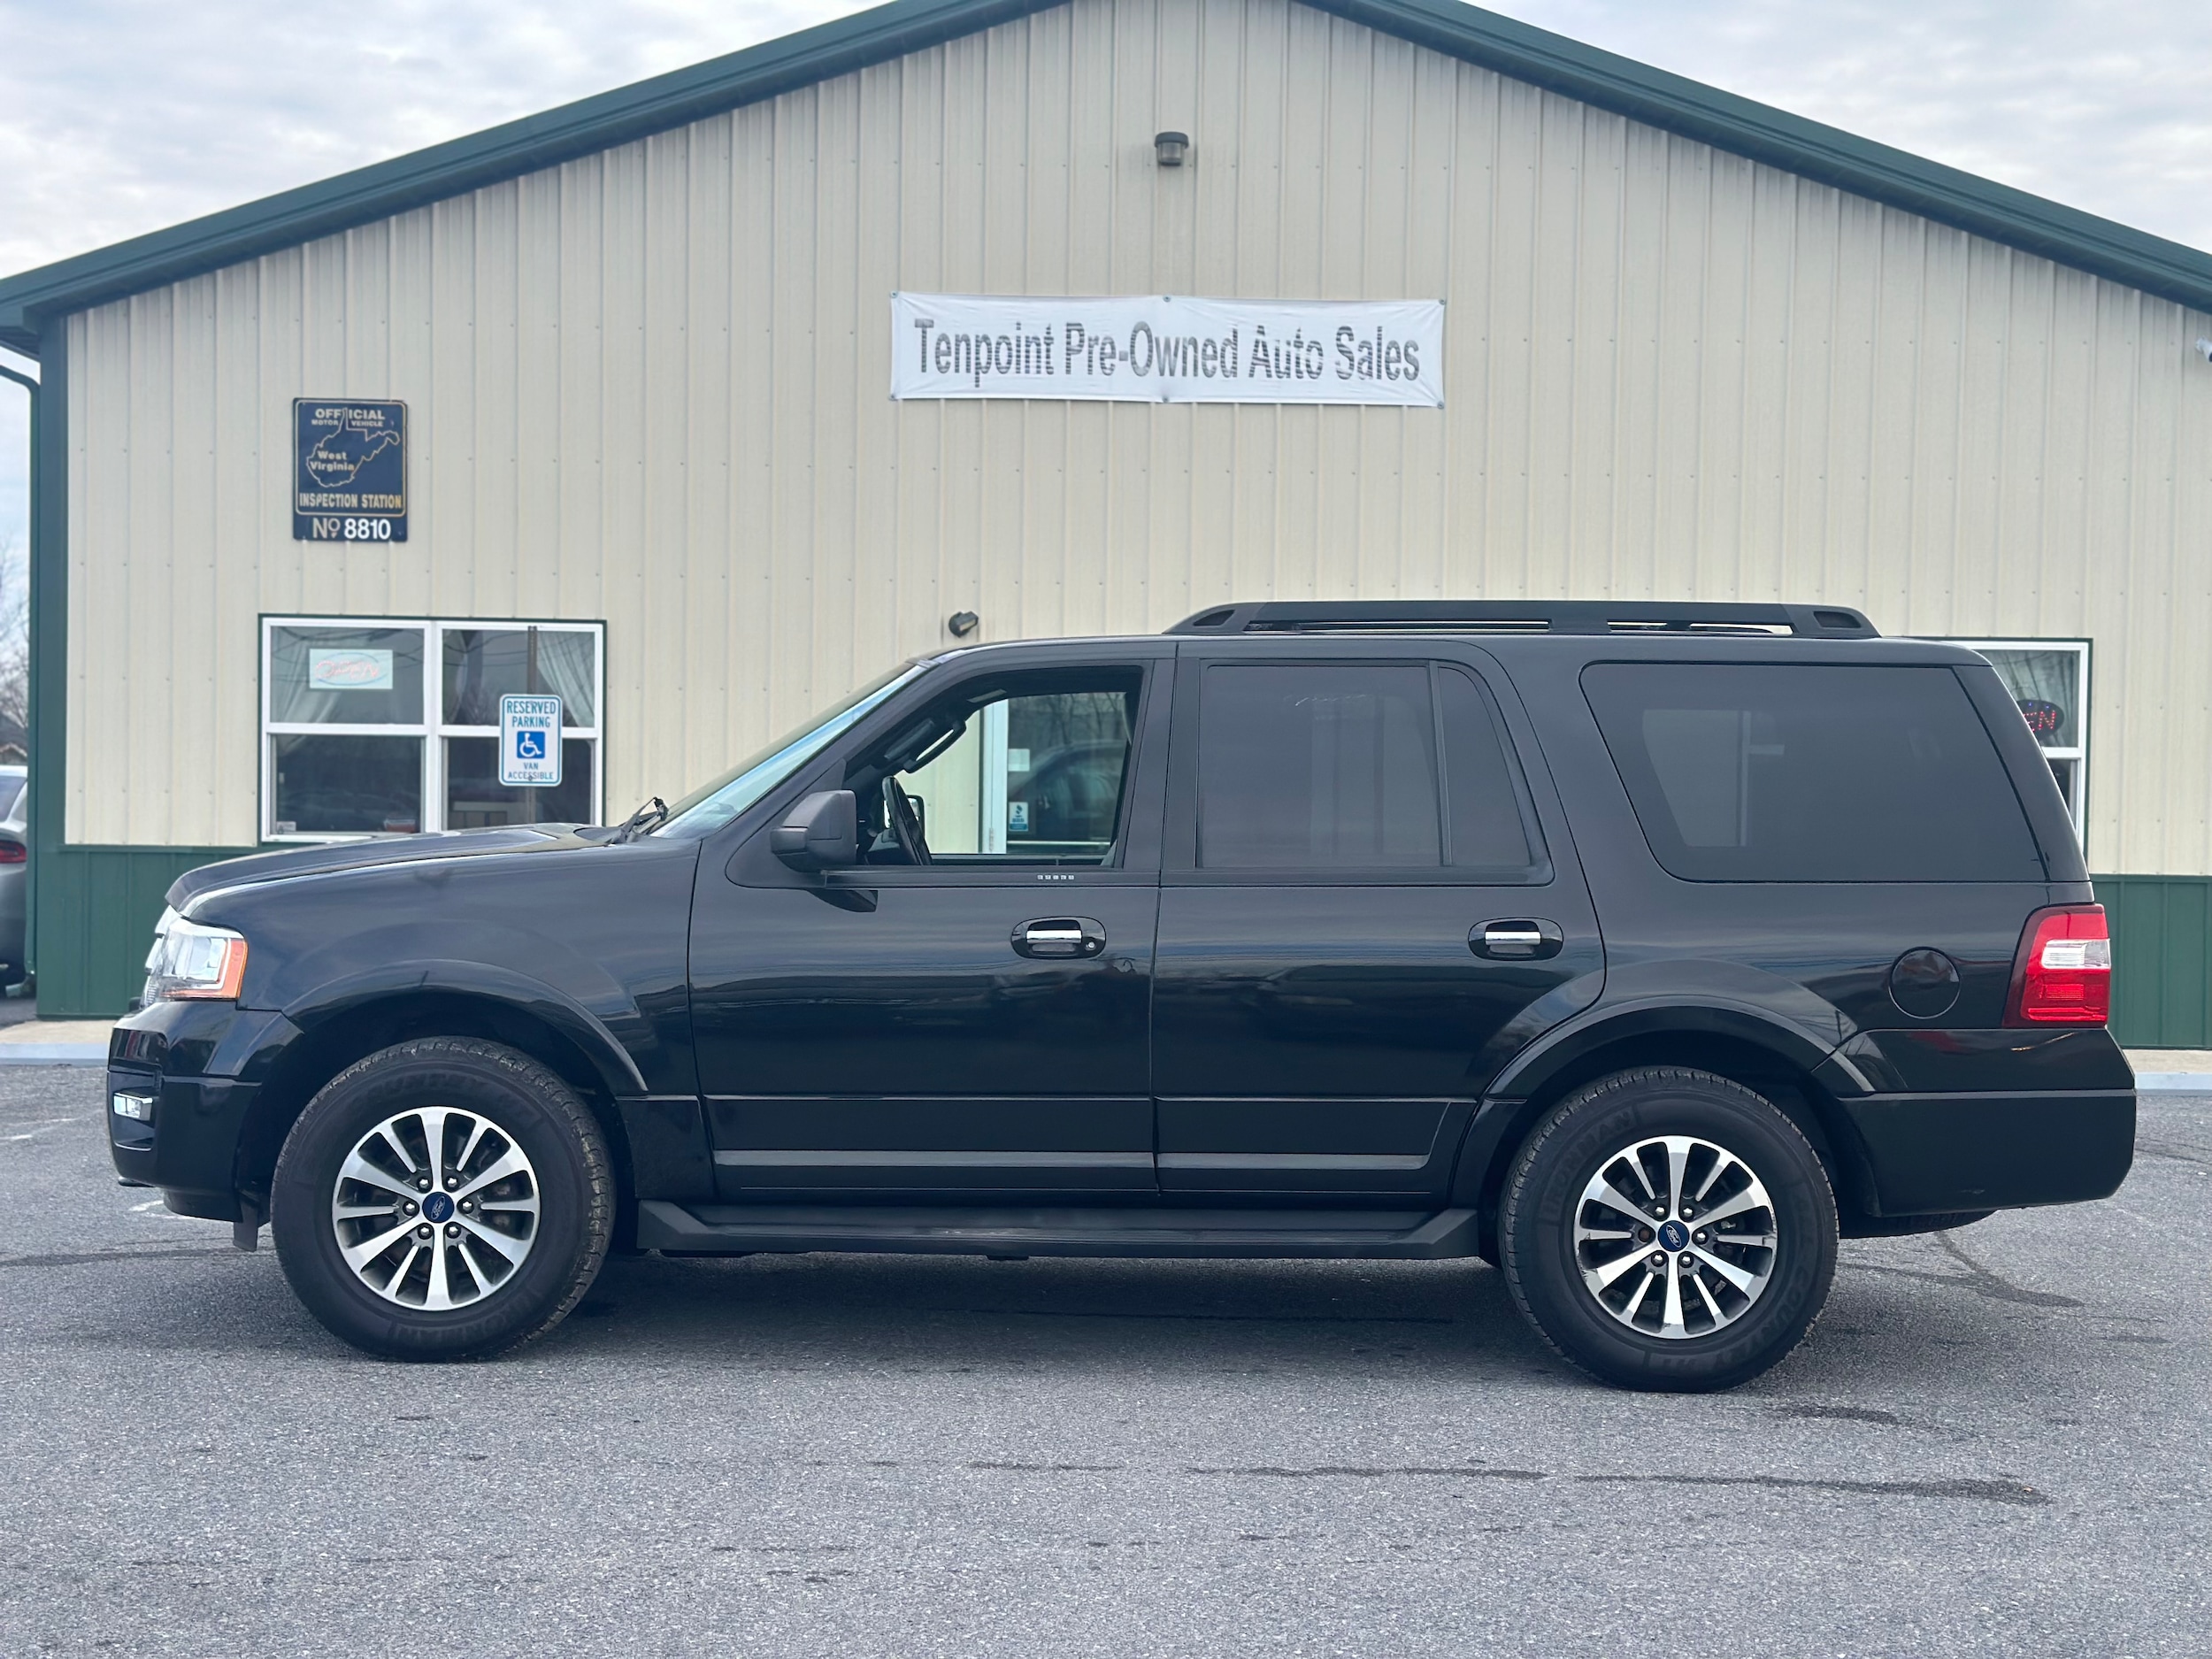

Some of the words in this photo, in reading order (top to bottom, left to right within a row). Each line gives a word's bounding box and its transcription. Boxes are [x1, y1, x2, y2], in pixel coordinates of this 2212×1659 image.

[914, 319, 1055, 388] Tenpoint
[1064, 320, 1239, 379] Pre-Owned
[1248, 325, 1325, 380] Auto
[1335, 325, 1419, 381] Sales
[317, 450, 348, 460] West
[310, 461, 356, 472] Virginia
[299, 493, 358, 508] INSPECTION
[361, 494, 403, 509] STATION
[343, 518, 392, 540] 8810
[506, 700, 557, 714] RESERVED
[511, 716, 551, 728] PARKING
[523, 762, 539, 771] VAN
[507, 772, 555, 780] ACCESSIBLE
